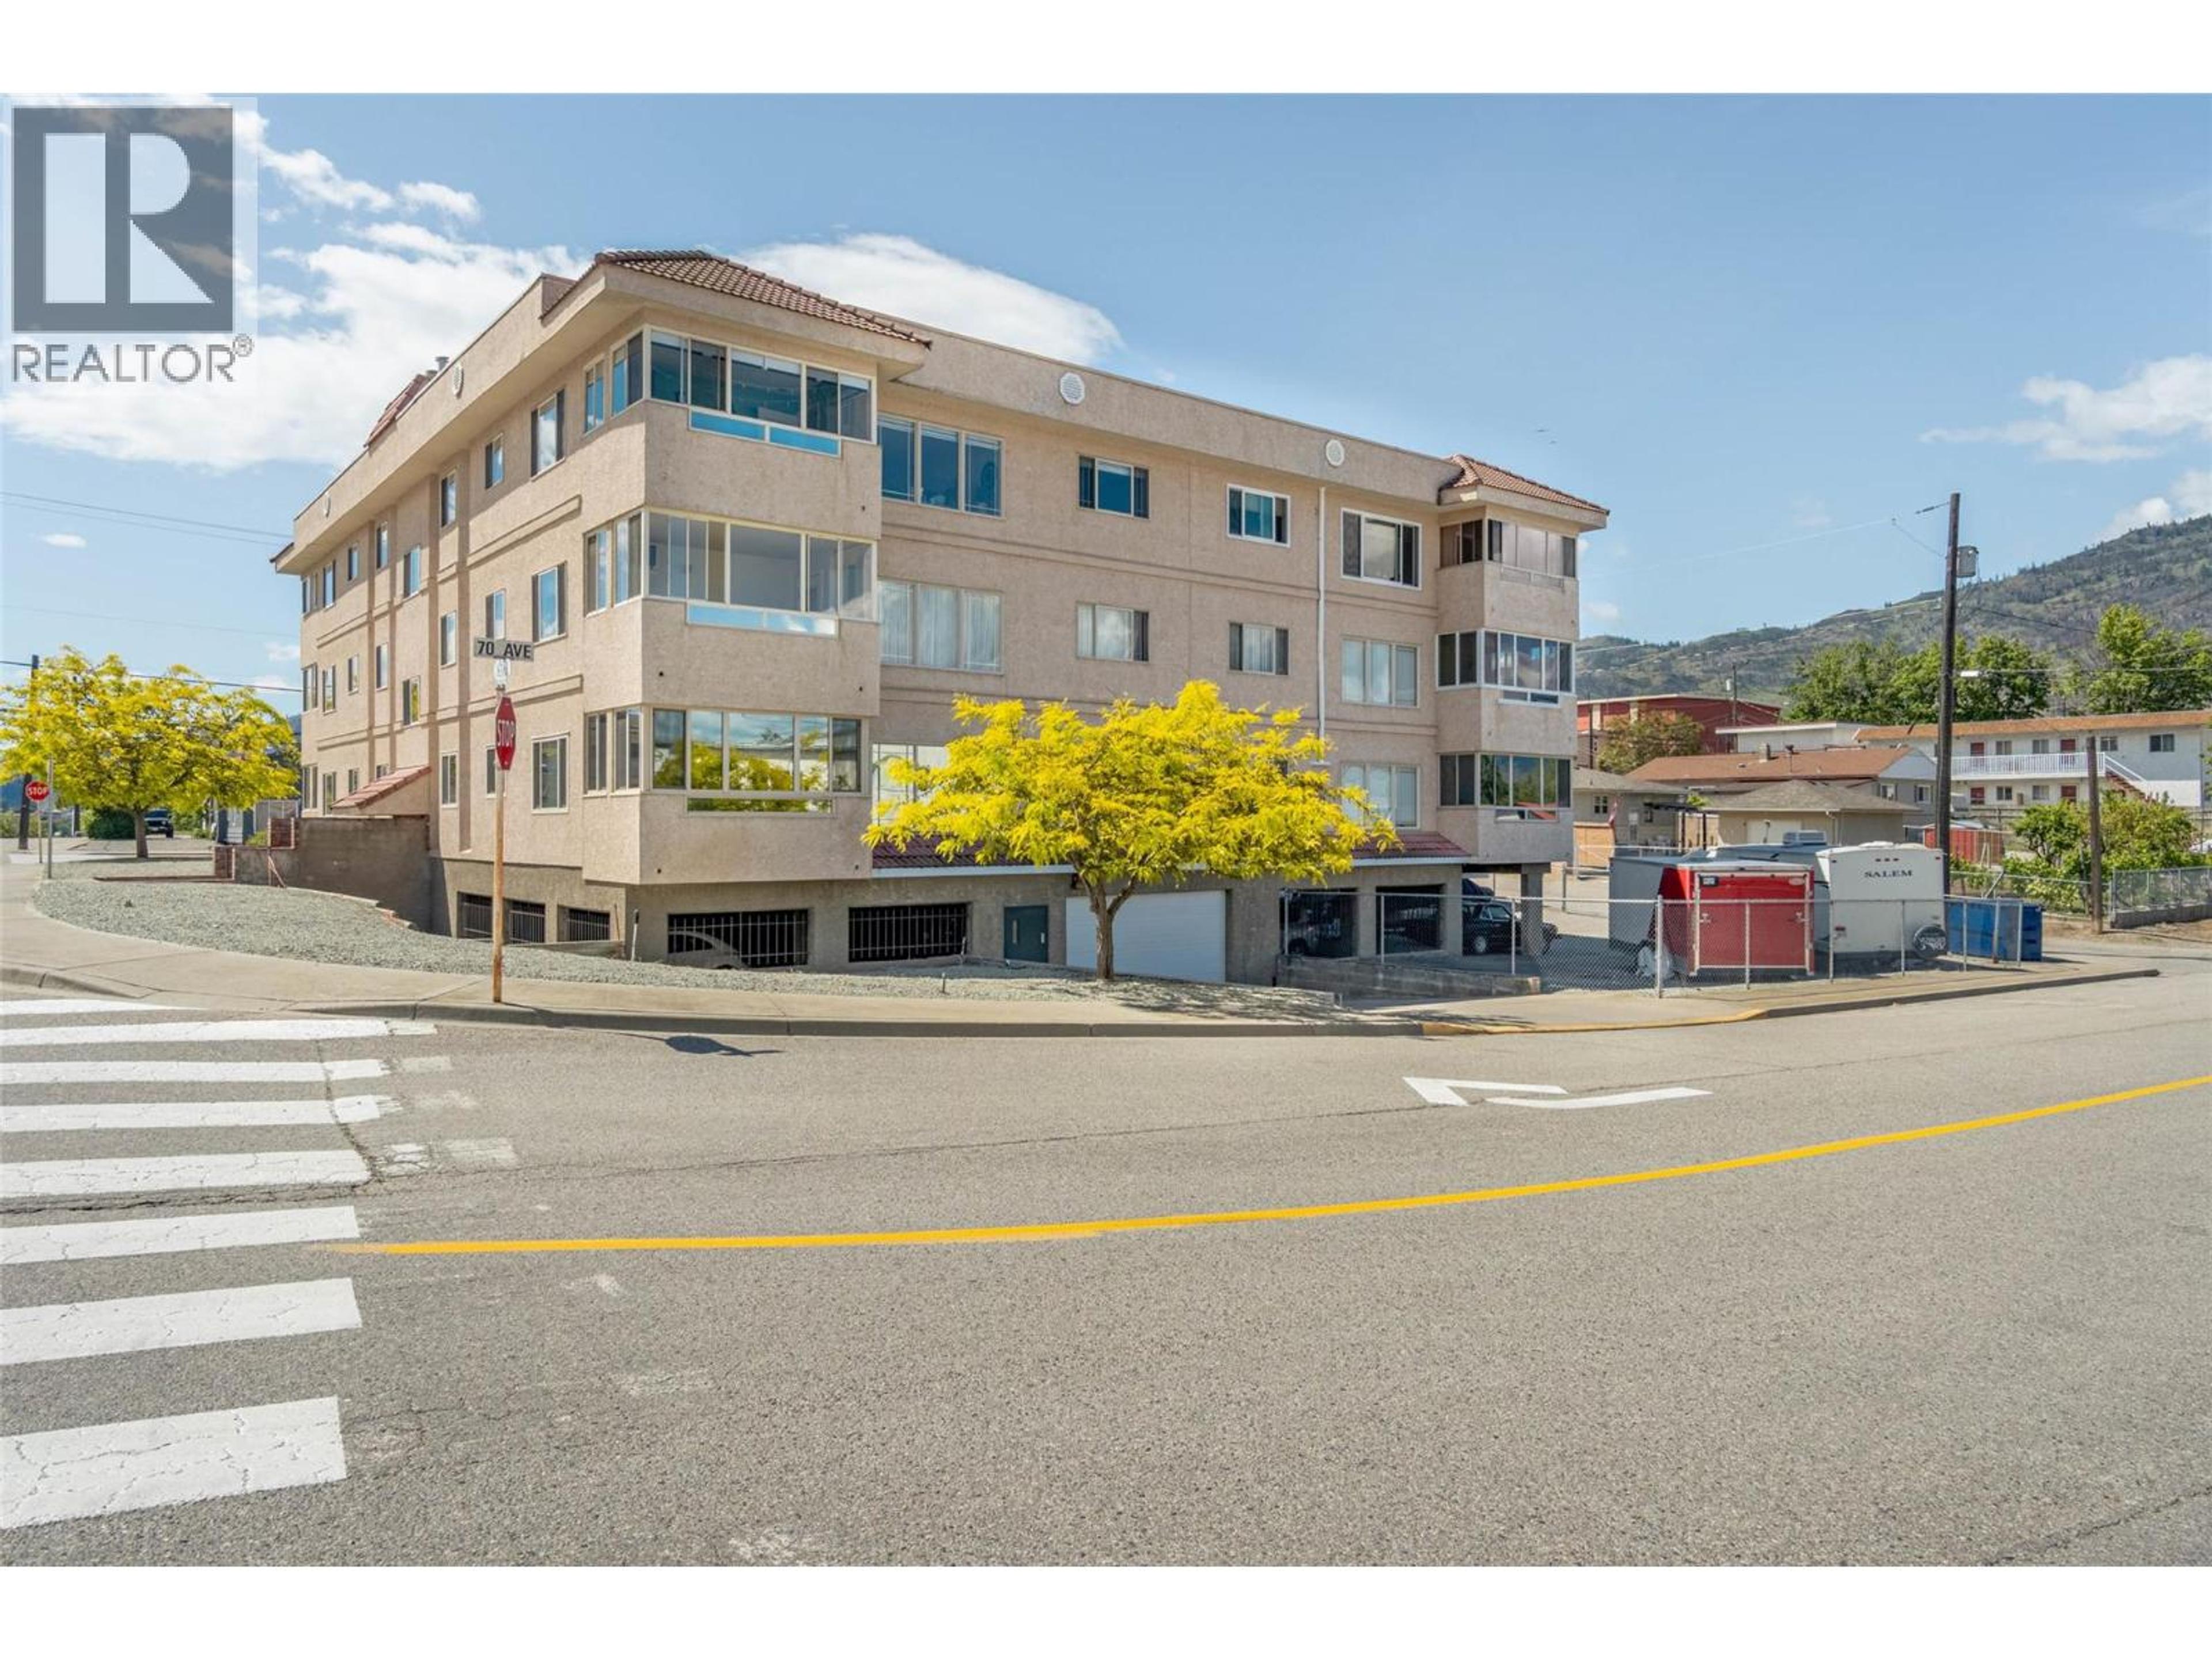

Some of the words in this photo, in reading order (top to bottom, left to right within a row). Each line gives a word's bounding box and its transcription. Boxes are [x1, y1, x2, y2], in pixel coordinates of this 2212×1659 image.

[477, 641, 495, 655] 70
[504, 642, 532, 658] AVE
[497, 719, 515, 747] STOP
[28, 786, 48, 796] STOP
